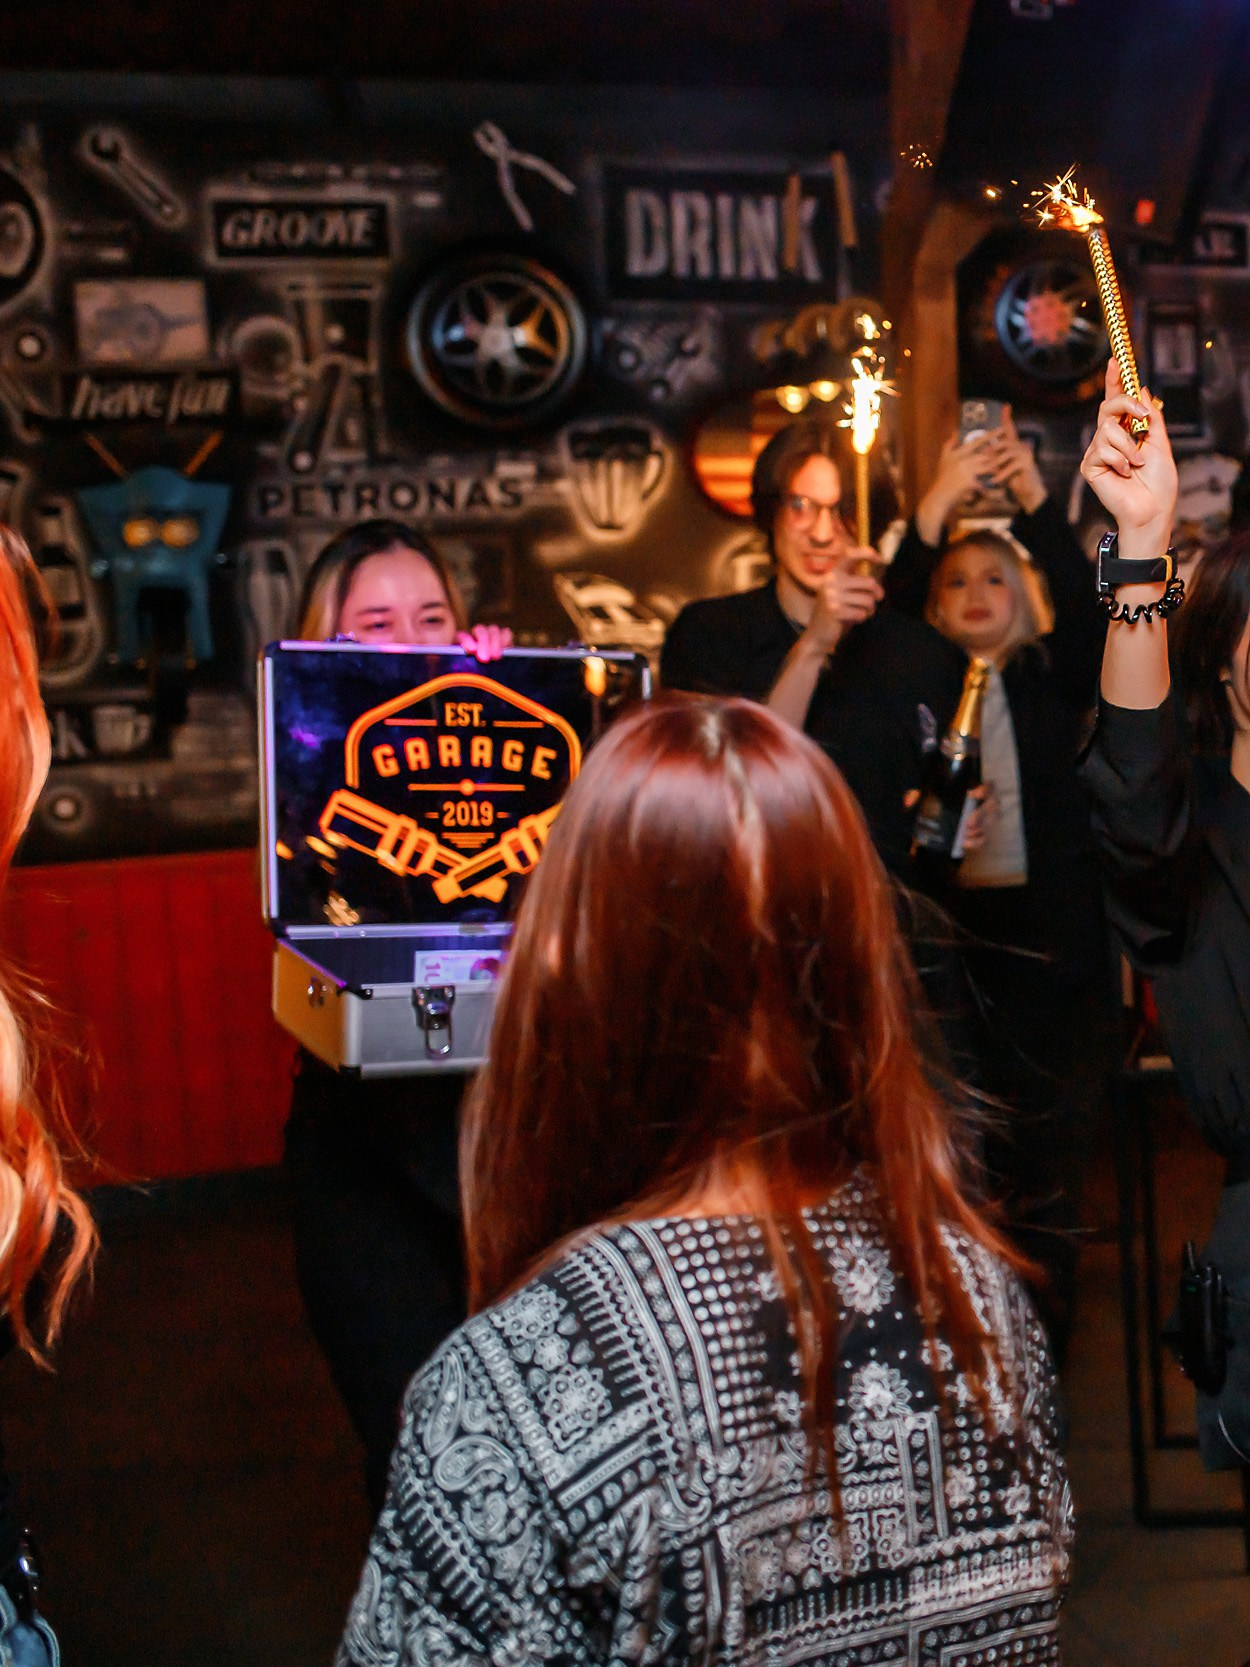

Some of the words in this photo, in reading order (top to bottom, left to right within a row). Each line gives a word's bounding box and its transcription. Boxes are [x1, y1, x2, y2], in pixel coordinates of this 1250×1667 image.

[627, 188, 822, 281] DRINK
[257, 477, 523, 514] PETRONAS
[444, 702, 486, 727] EST.
[371, 735, 558, 780] GARAGE
[442, 801, 494, 827] 2019
